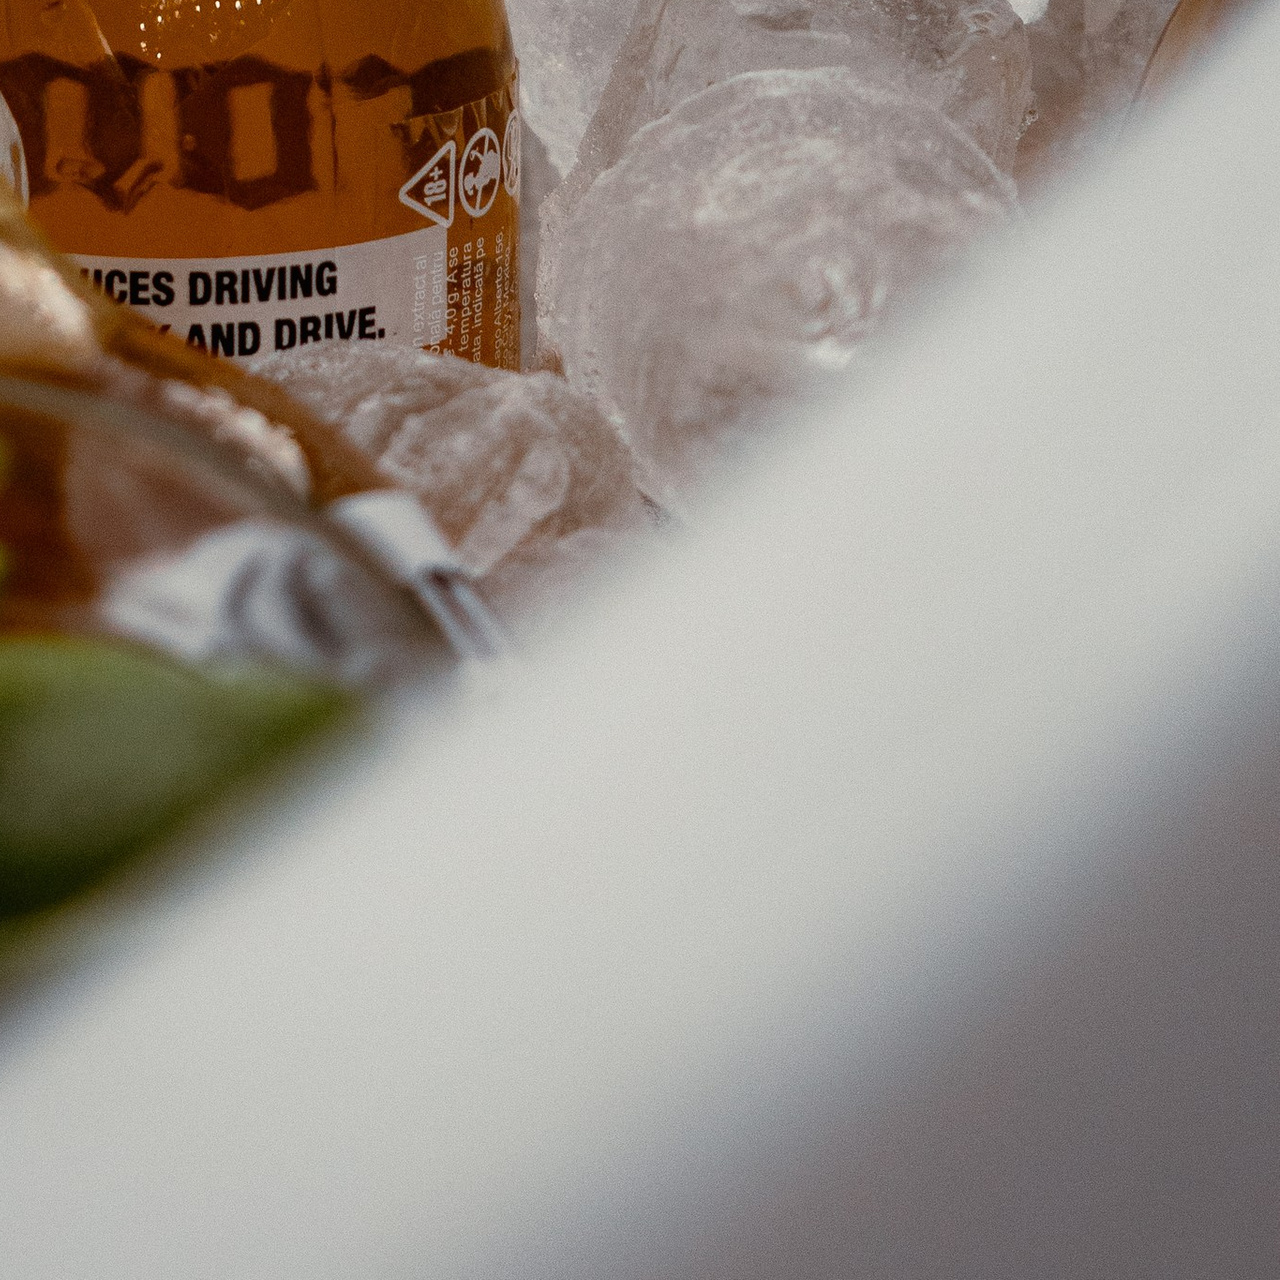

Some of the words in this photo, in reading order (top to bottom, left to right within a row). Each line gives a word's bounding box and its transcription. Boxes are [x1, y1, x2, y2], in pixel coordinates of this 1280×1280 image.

[424, 166, 447, 206] 18+
[448, 247, 459, 268] se
[476, 237, 485, 258] pe
[189, 260, 338, 305] DRIVING
[432, 251, 444, 305] pentru
[459, 242, 473, 352] temperatura
[413, 276, 425, 332] extract
[275, 306, 386, 350] DRIVE.
[429, 309, 441, 354] onală
[473, 329, 483, 362] ata,
